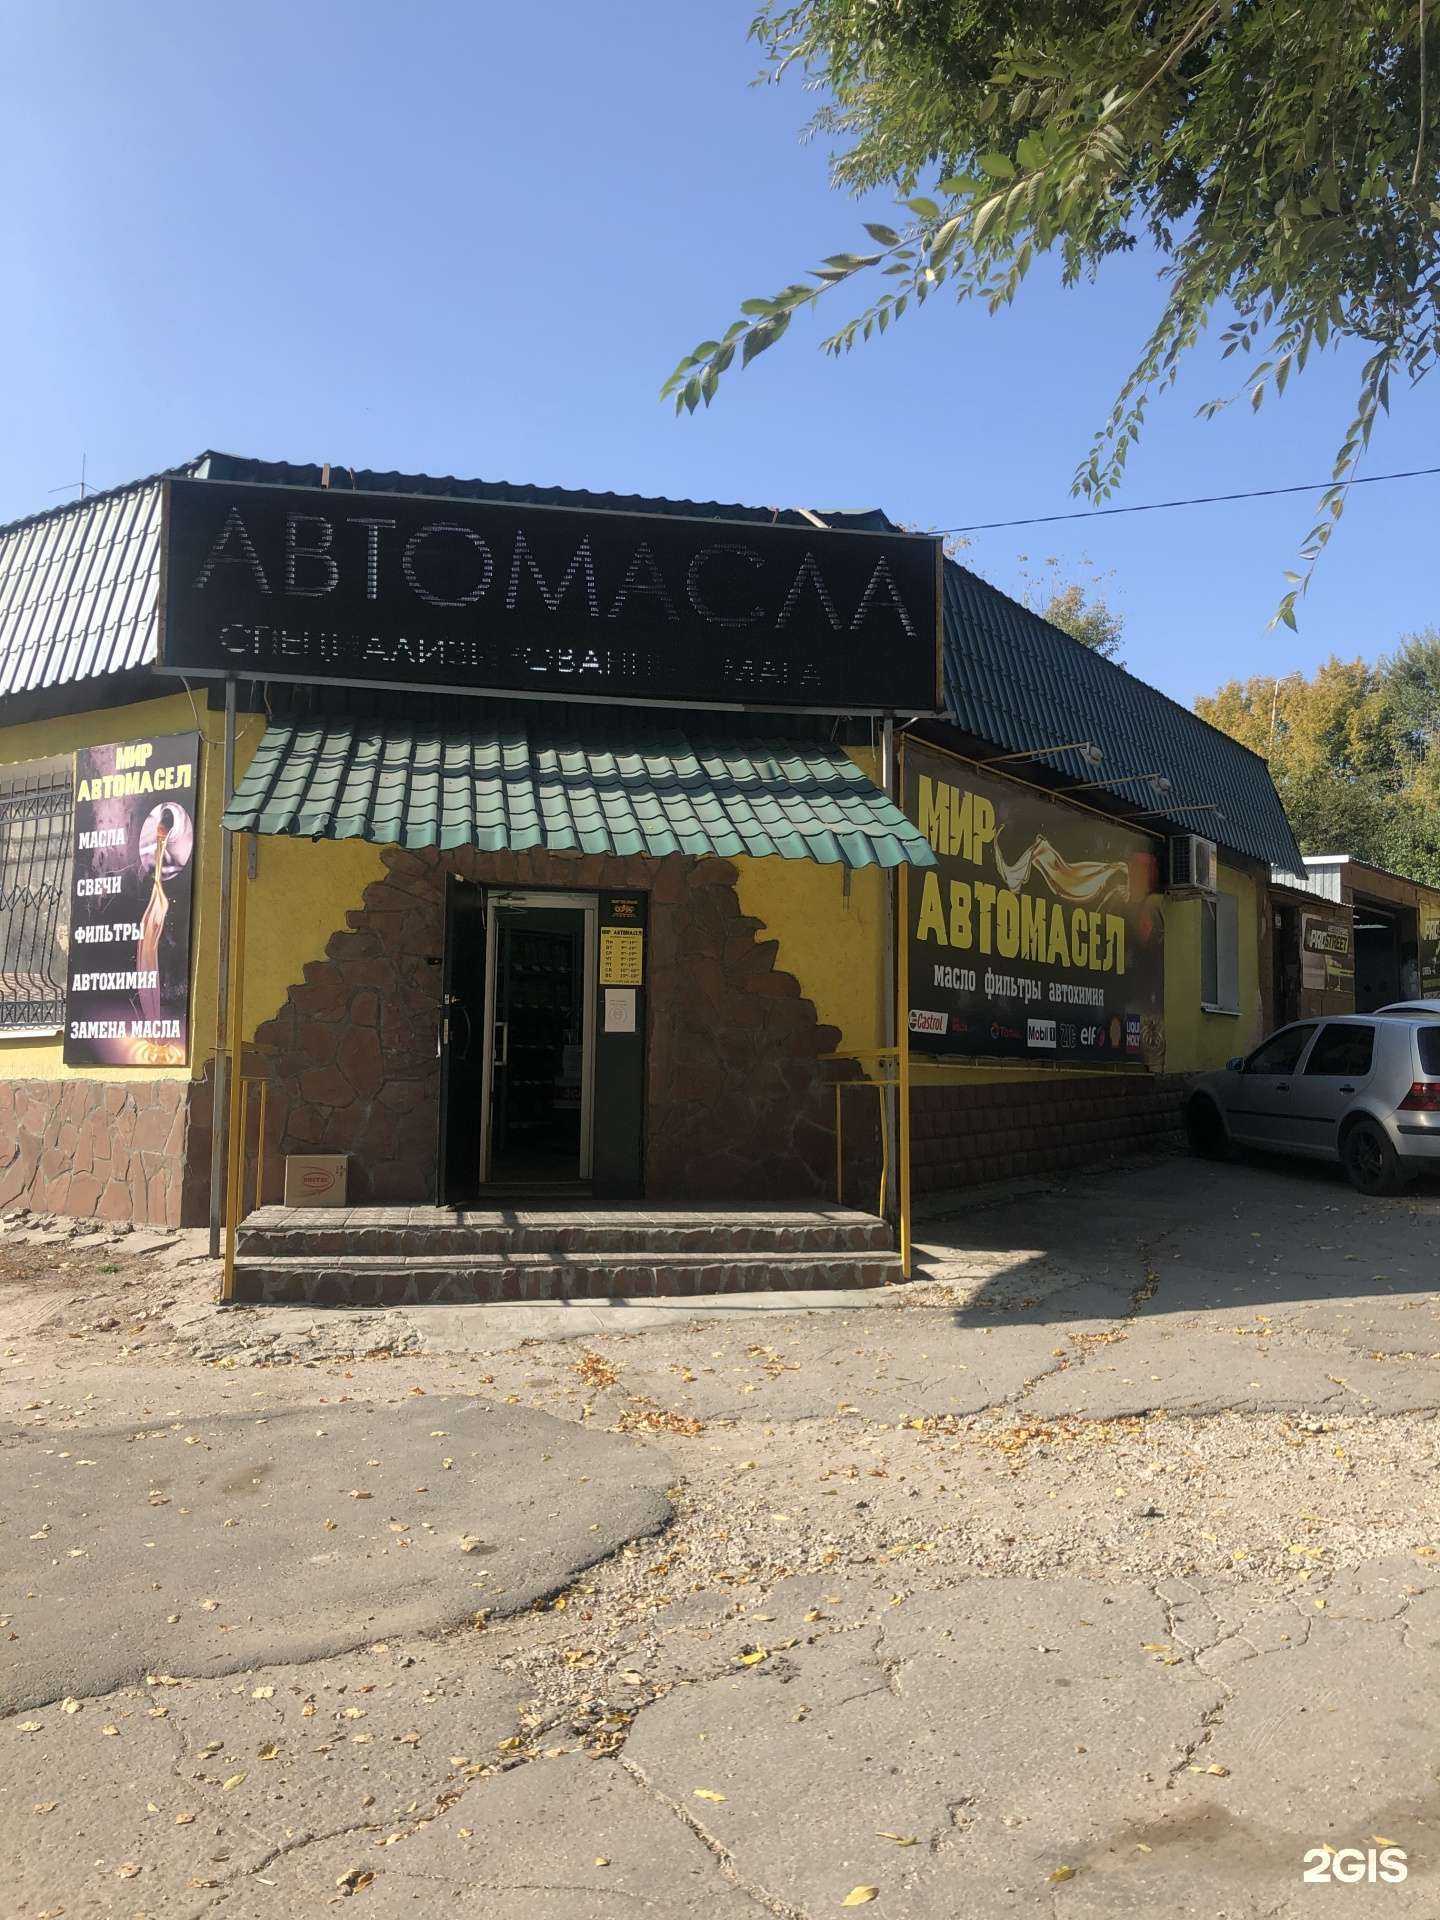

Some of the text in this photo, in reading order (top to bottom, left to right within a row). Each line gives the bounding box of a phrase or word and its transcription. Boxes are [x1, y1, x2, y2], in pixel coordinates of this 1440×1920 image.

[192, 503, 918, 639] АВТОМАСЛА
[115, 743, 152, 769] МИР
[77, 764, 192, 801] АВТОМАСЕЛ
[918, 774, 997, 866] МИР
[78, 828, 126, 849] МАСЛА
[76, 876, 122, 897] СВЕЧИ
[74, 923, 144, 943] ФИЛЬТРЫ
[916, 870, 1126, 976] АВТОМАСЕЛ
[72, 970, 158, 991] АВТОХИМИЯ
[933, 964, 1105, 1007] масло фильтры автохимия
[70, 1019, 181, 1039] ЗАМЕНА МАСЛА
[917, 1012, 944, 1031] Castrol
[1028, 1025, 1048, 1041] Mobil
[1080, 1026, 1097, 1046] elf
